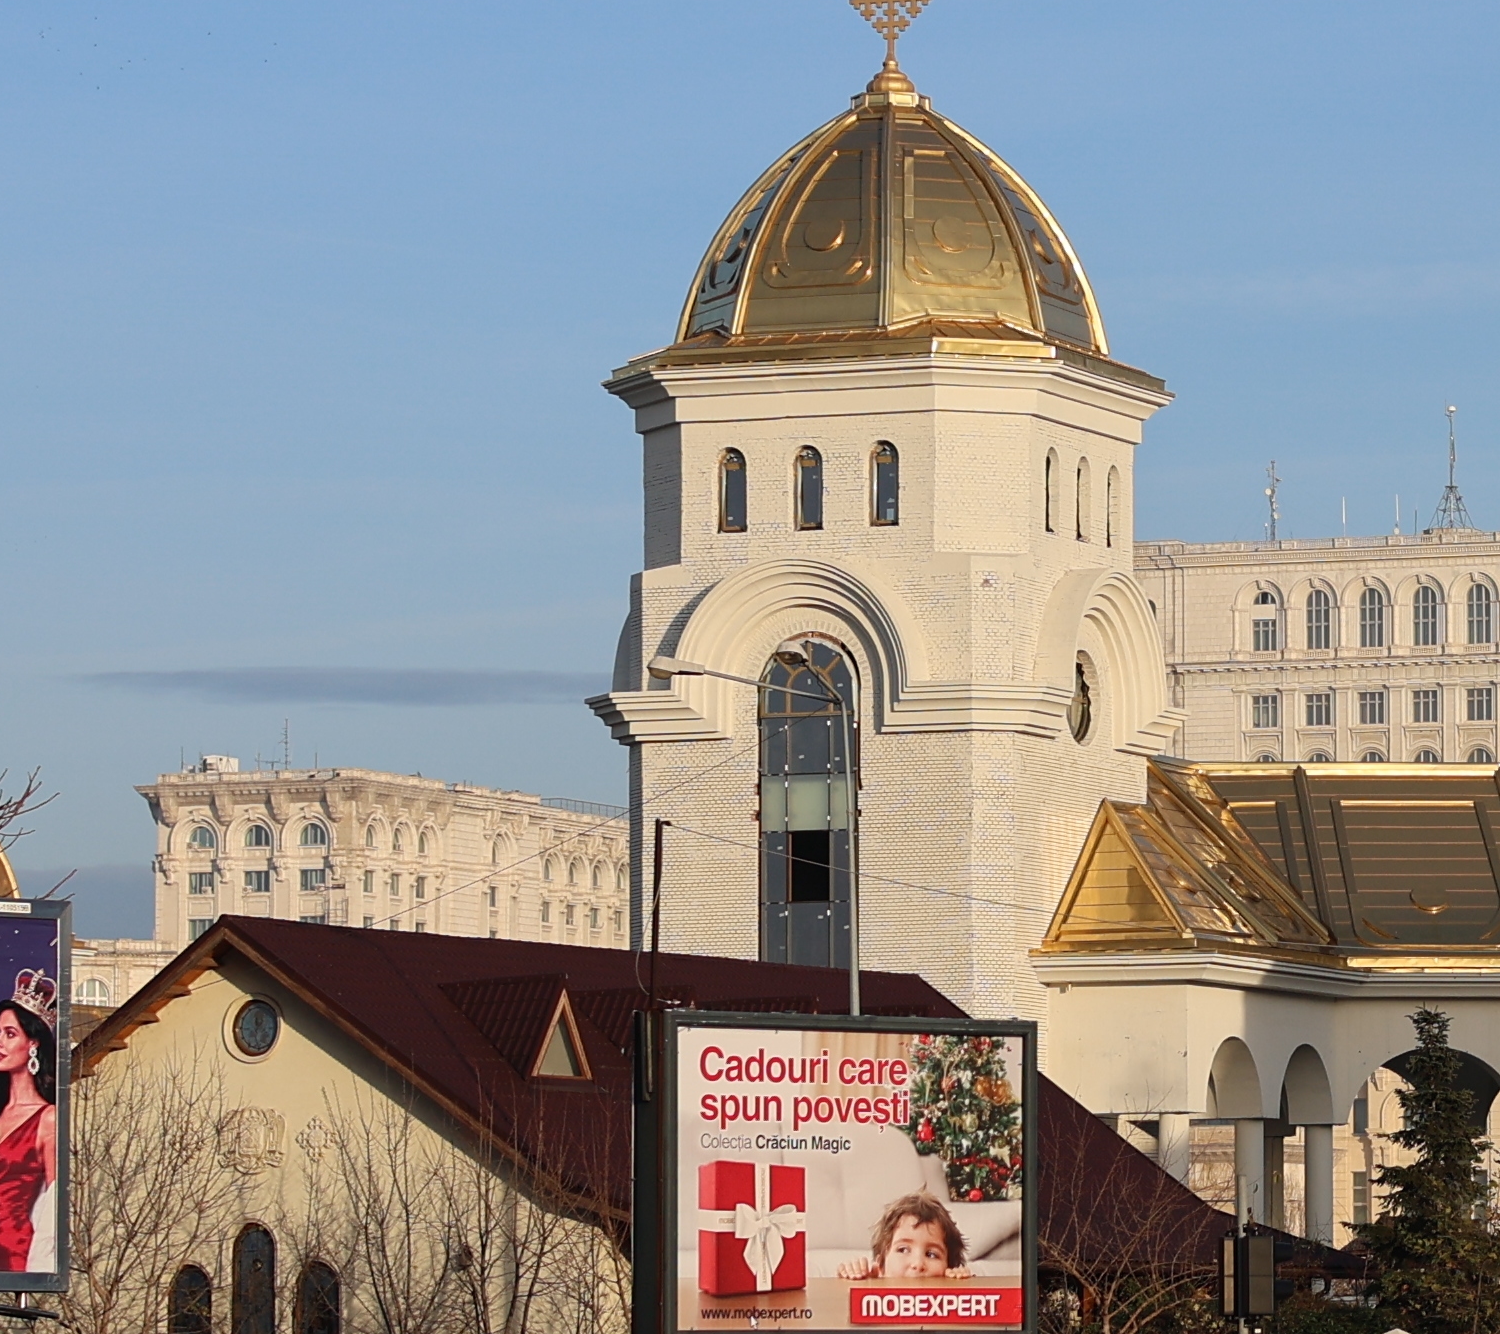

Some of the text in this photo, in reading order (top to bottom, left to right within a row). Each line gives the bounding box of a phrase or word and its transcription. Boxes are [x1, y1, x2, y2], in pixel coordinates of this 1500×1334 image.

[700, 1046, 908, 1085] Cadouri care
[700, 1091, 909, 1133] spun povești
[701, 1133, 852, 1154] Colecția Crăciun Magic
[701, 1306, 813, 1322] www.mobexpert.ro
[861, 1294, 1001, 1317] MOBEXPERT
